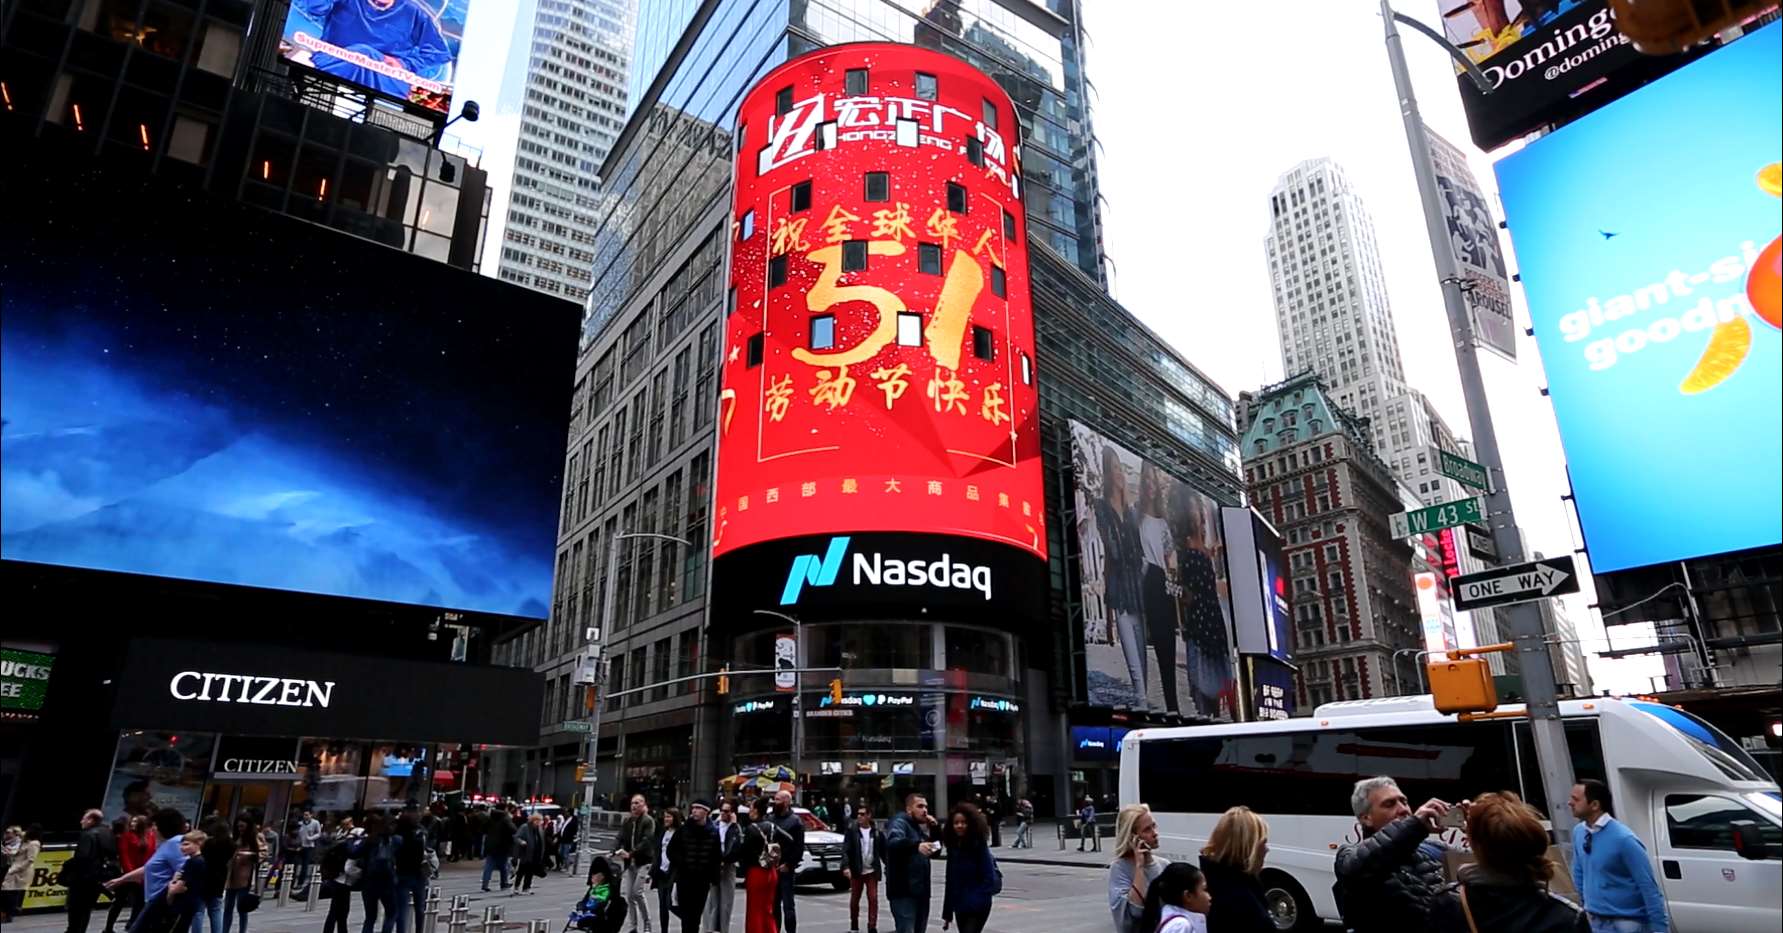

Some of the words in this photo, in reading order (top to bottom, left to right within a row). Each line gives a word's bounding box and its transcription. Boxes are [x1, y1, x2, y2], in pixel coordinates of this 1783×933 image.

[297, 33, 441, 92] SupremeMasterTV.com
[837, 130, 952, 150] HONGZENG
[772, 202, 1005, 269] 祝全球华人
[791, 239, 984, 372] 51
[765, 363, 1010, 426] 劳动节快乐
[1411, 511, 1428, 531] W
[1437, 505, 1459, 526] 43
[852, 553, 992, 601] Nasdaq
[1469, 580, 1504, 598] ONE
[1518, 570, 1555, 589] WAY
[169, 671, 336, 708] CITIZEN
[224, 758, 299, 773] CITIZEN
